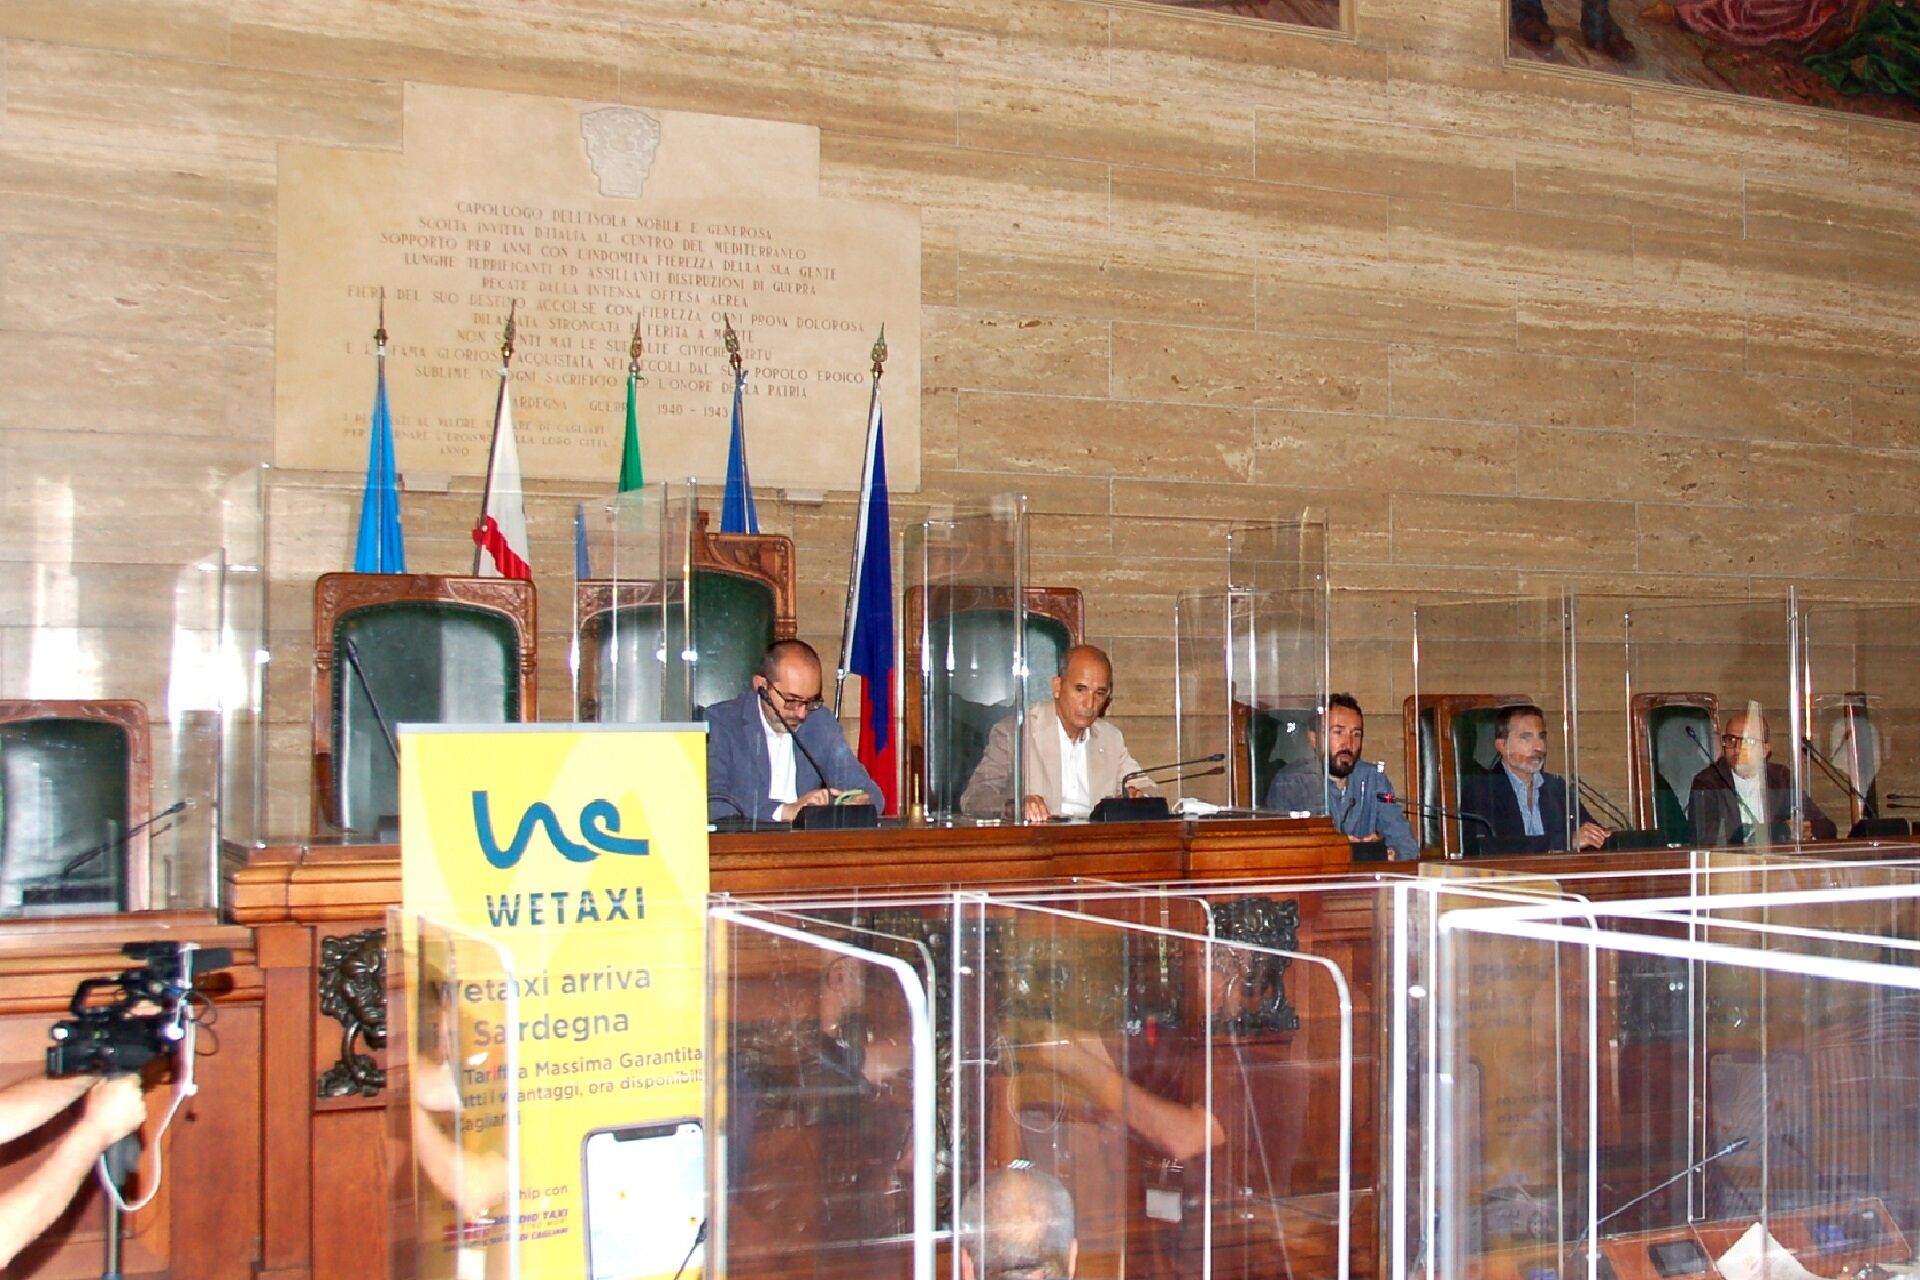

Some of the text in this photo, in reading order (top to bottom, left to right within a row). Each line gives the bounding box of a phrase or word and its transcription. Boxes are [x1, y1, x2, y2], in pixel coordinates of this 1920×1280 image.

[457, 201, 543, 219] CAPOLUOGO
[637, 216, 681, 232] NOBILE
[690, 222, 697, 233] E
[707, 224, 773, 240] GENEROSA
[419, 216, 807, 260] SCOLTA INVITTA D'ITALIA AL CENTRO DEL MEDITERRANEO
[404, 252, 816, 296] LUNGHE TERRIFICANTI ED ASSILLANTI DISTRUZIONI DI GUERRA
[467, 239, 492, 252] PER
[503, 242, 532, 257] ANNI
[541, 245, 568, 258] CON
[657, 254, 714, 271] FIEREZZA
[723, 259, 761, 274] DELLA
[771, 262, 790, 275] SUA
[799, 265, 837, 281] GENTE
[482, 276, 749, 308] RECATE DALLA INTENSA OFFESA AEREA
[397, 288, 419, 302] DEL
[432, 291, 459, 305] SUO
[536, 297, 596, 315] ACCOLSE
[605, 303, 633, 317] CON
[642, 306, 701, 323] FIEREZZA
[751, 314, 788, 329] PROVA
[796, 317, 865, 333] DOLOROSA
[457, 329, 486, 343] NON
[551, 336, 572, 348] MAI
[581, 338, 595, 350] LE
[549, 319, 620, 333] STRONCATA
[647, 325, 689, 338] FERITA
[698, 328, 705, 339] A
[392, 345, 425, 358] FAMA
[518, 353, 594, 369] ACQUISTATA
[603, 357, 624, 370] NEI
[638, 359, 681, 374] ECOLI
[689, 363, 710, 376] DAL
[755, 367, 809, 383] POPOLO
[818, 370, 865, 385] EROICO
[415, 366, 471, 380] SUBLIME
[545, 374, 618, 388] SACRIFICIO
[768, 384, 808, 399] PATRIA
[513, 396, 568, 411] ARDEGNA
[657, 403, 683, 417] 1940
[703, 405, 729, 418] 1943
[486, 886, 645, 927] WETAXI
[562, 965, 651, 994] arriva
[473, 1012, 630, 1047] Sardegna
[535, 1056, 612, 1078] Massima
[620, 1047, 703, 1069] Garantita
[545, 1185, 568, 1197] con
